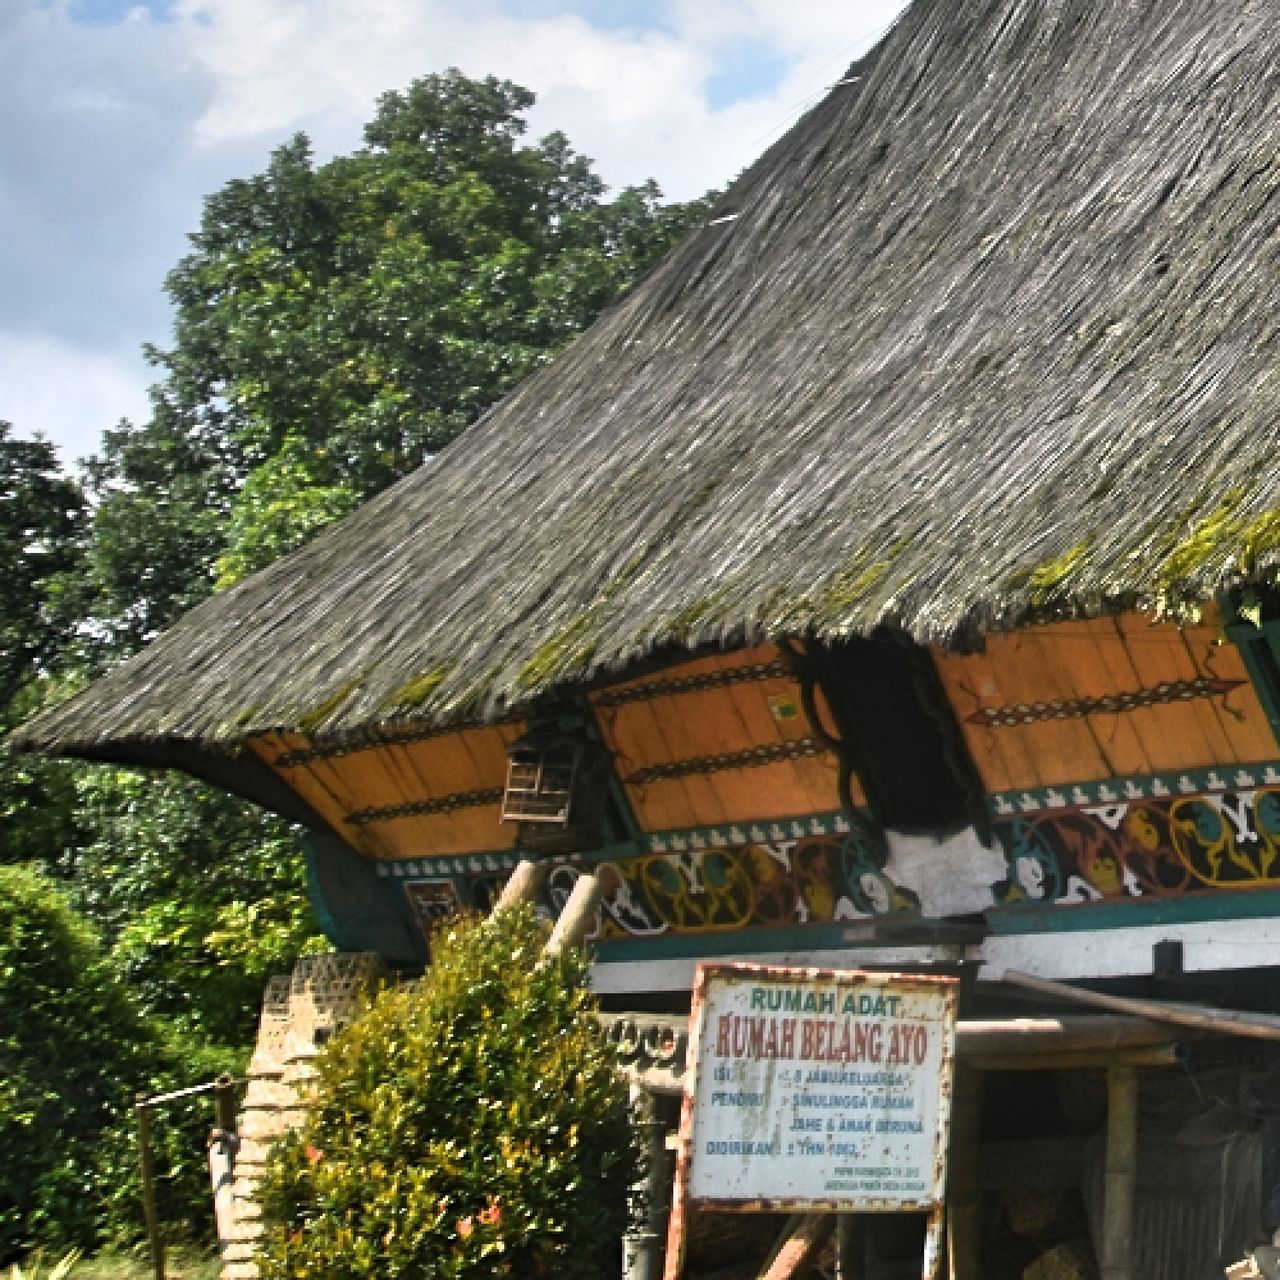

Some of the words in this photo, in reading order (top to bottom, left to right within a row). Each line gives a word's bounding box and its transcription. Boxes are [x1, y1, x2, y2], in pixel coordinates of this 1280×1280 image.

[750, 987, 835, 1014] RUMAH
[842, 993, 901, 1018] ADAT
[716, 1016, 796, 1060] RUMAH
[800, 1019, 883, 1063] BELANG
[886, 1023, 928, 1066] AYO
[793, 1094, 868, 1109] SINULINGGA
[870, 1095, 915, 1109] RUMAH
[789, 1118, 824, 1132] JAHE
